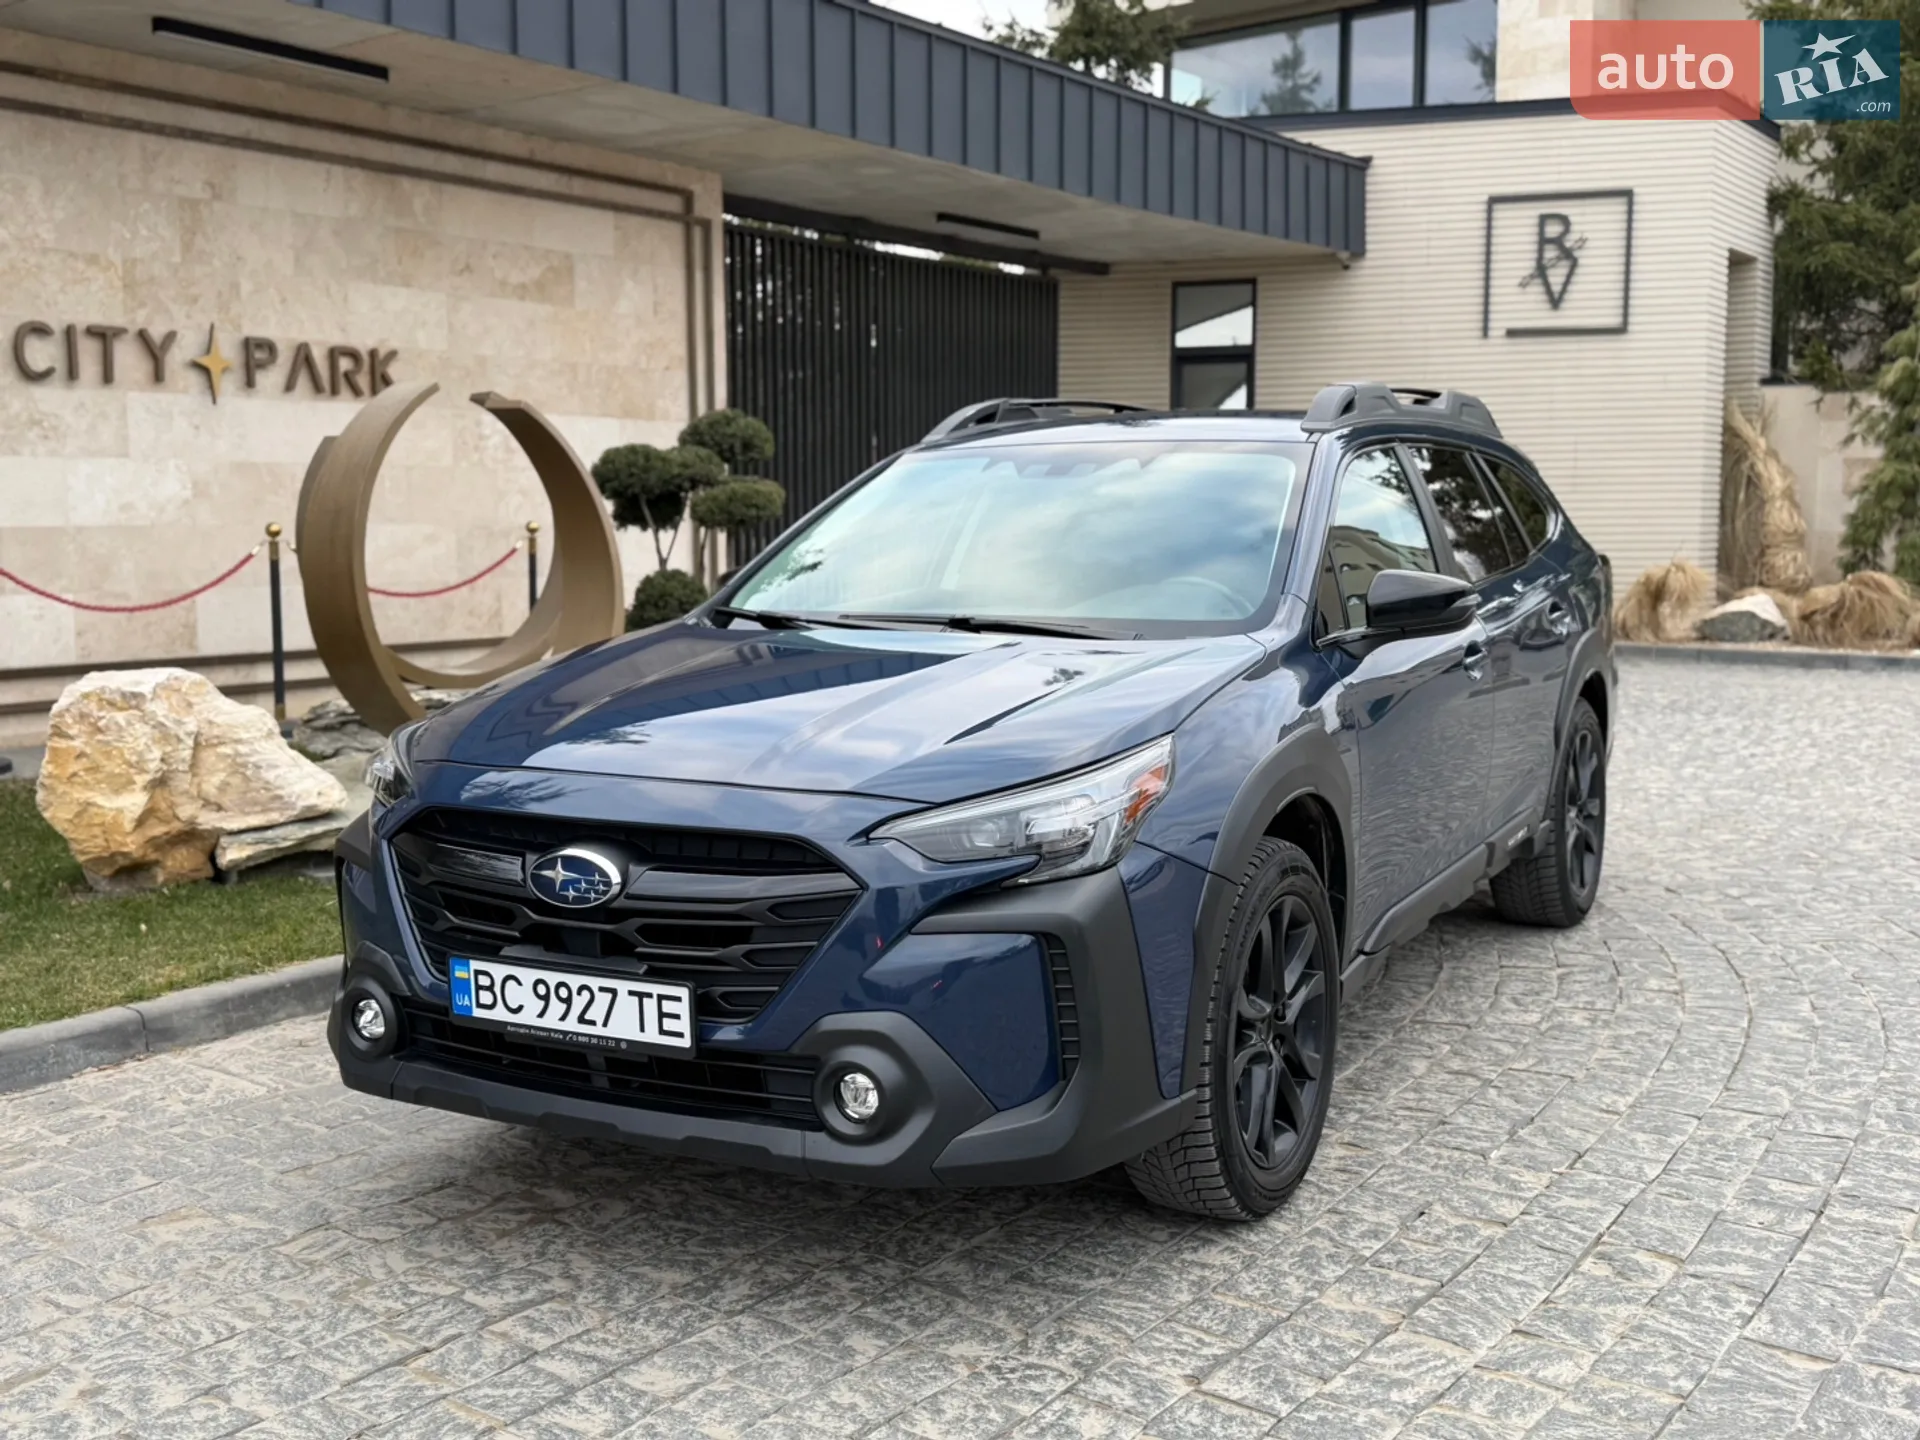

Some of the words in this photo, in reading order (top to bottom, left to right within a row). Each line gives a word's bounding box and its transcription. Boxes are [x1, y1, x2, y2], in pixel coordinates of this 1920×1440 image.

[13, 319, 178, 384] CITY
[243, 336, 399, 398] PARK
[455, 993, 472, 1008] UA
[472, 968, 525, 1015] BC
[531, 977, 619, 1028] 9927
[627, 989, 686, 1039] TE
